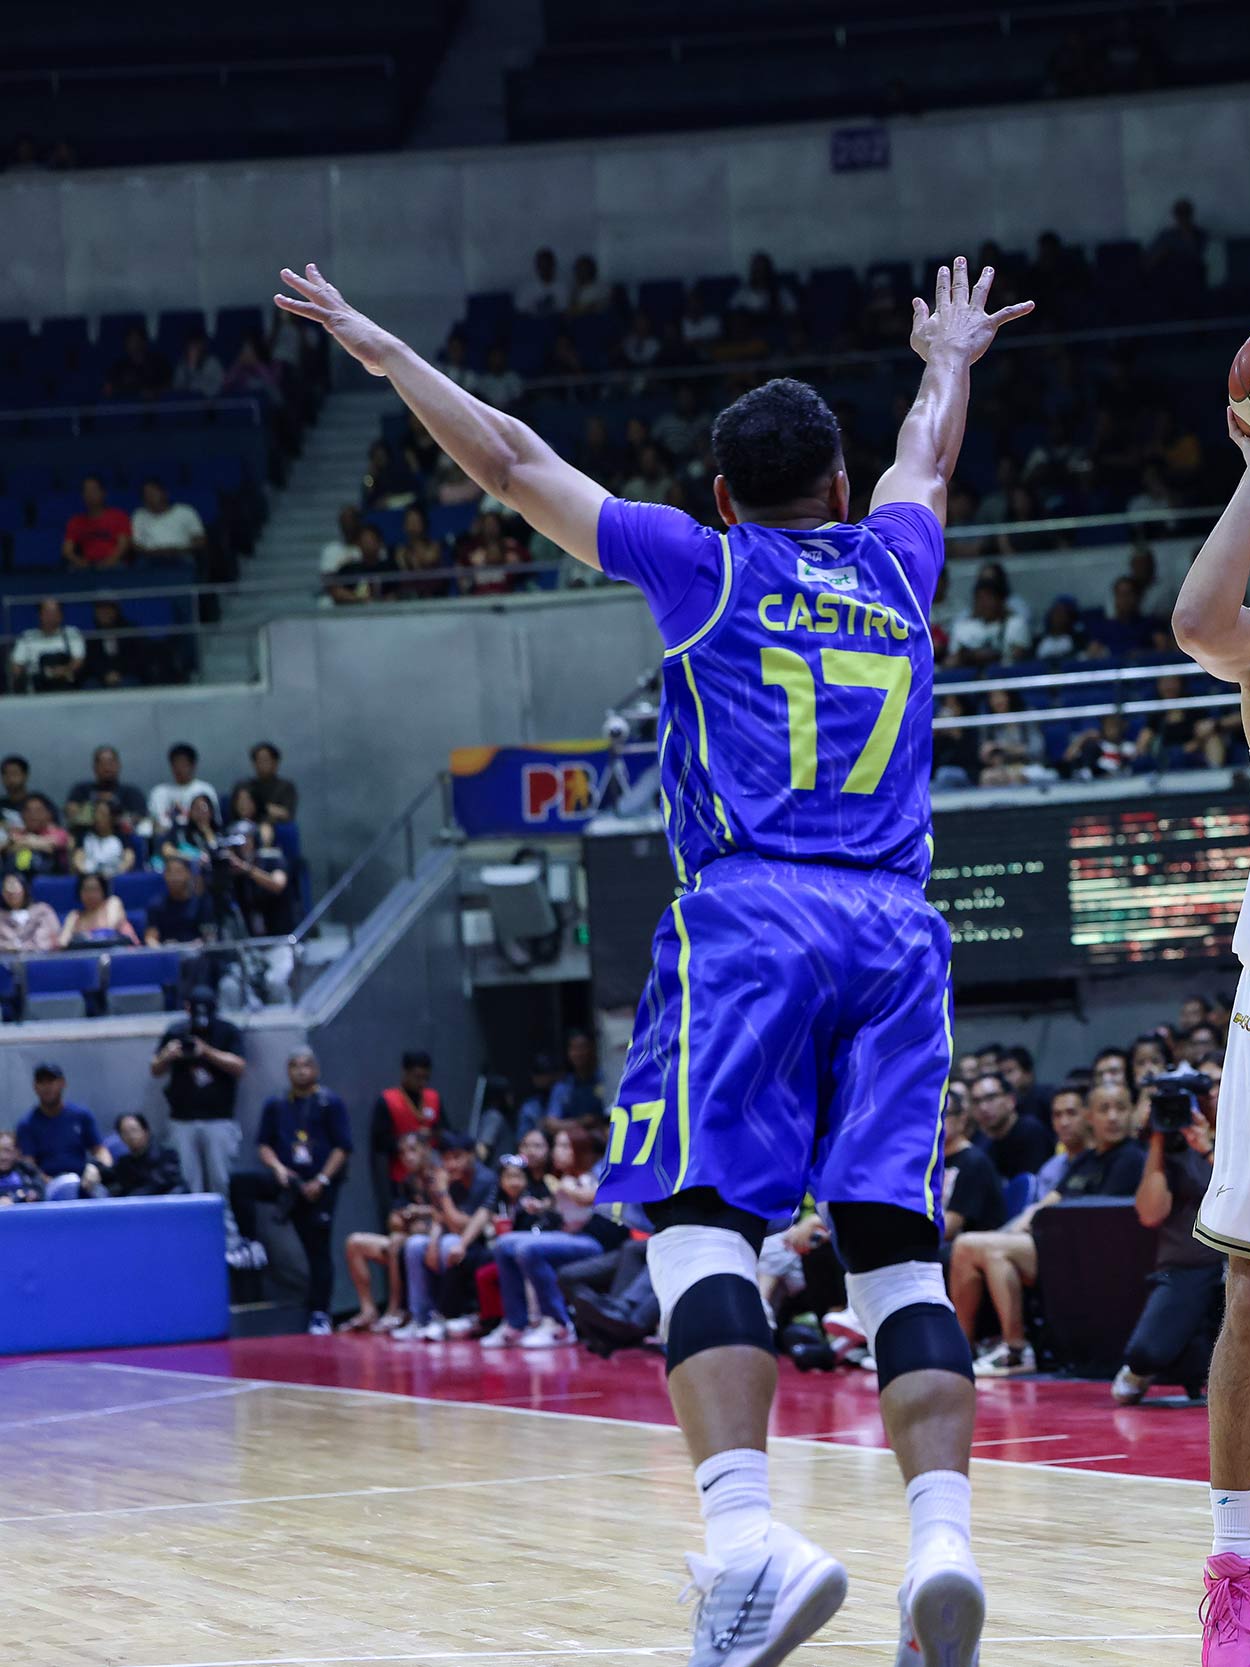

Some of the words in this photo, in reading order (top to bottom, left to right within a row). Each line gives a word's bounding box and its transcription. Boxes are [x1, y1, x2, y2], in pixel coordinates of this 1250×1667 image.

[758, 592, 909, 640] CASTRO
[760, 647, 913, 795] 17
[609, 1097, 666, 1166] 17
